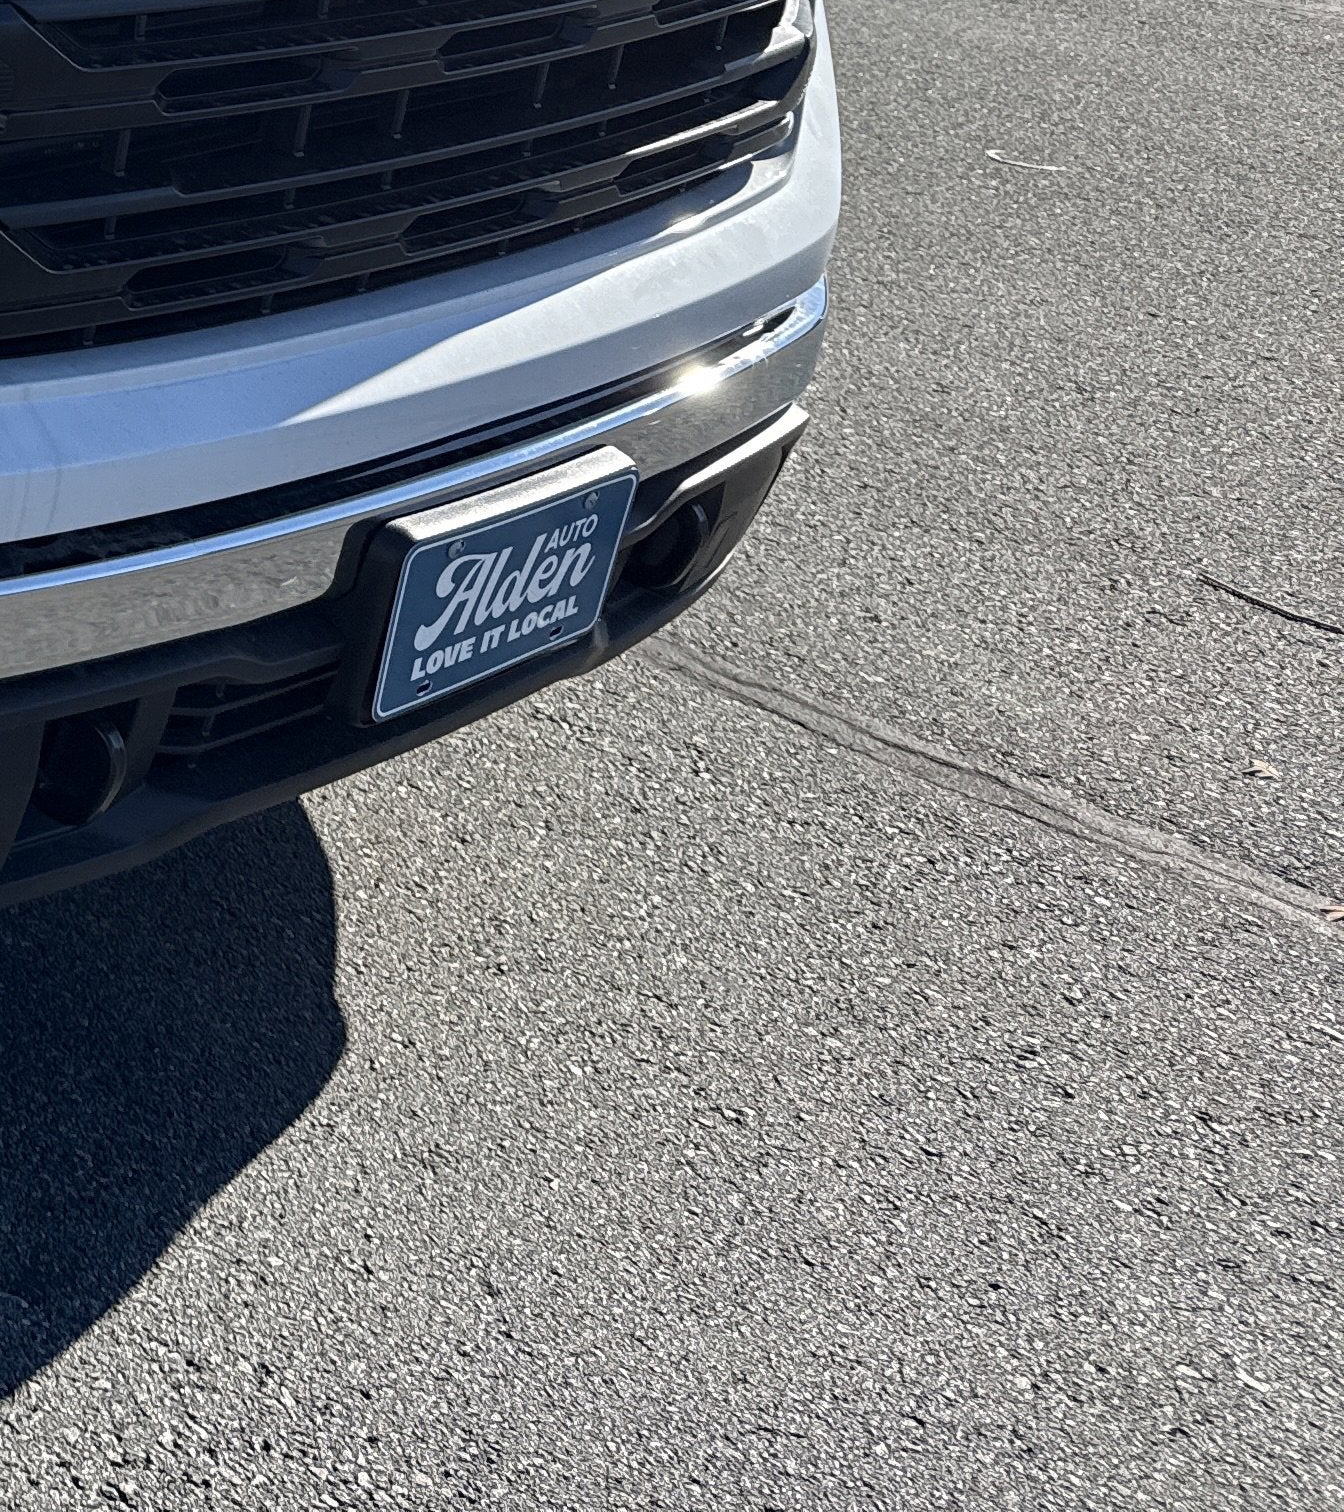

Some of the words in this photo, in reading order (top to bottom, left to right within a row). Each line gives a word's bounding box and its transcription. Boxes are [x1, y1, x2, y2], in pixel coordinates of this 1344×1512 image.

[543, 513, 599, 554] AUTO
[413, 533, 596, 652] Alden
[410, 636, 477, 682] LOVE
[479, 624, 506, 654] IT
[506, 595, 579, 643] LOCAL
